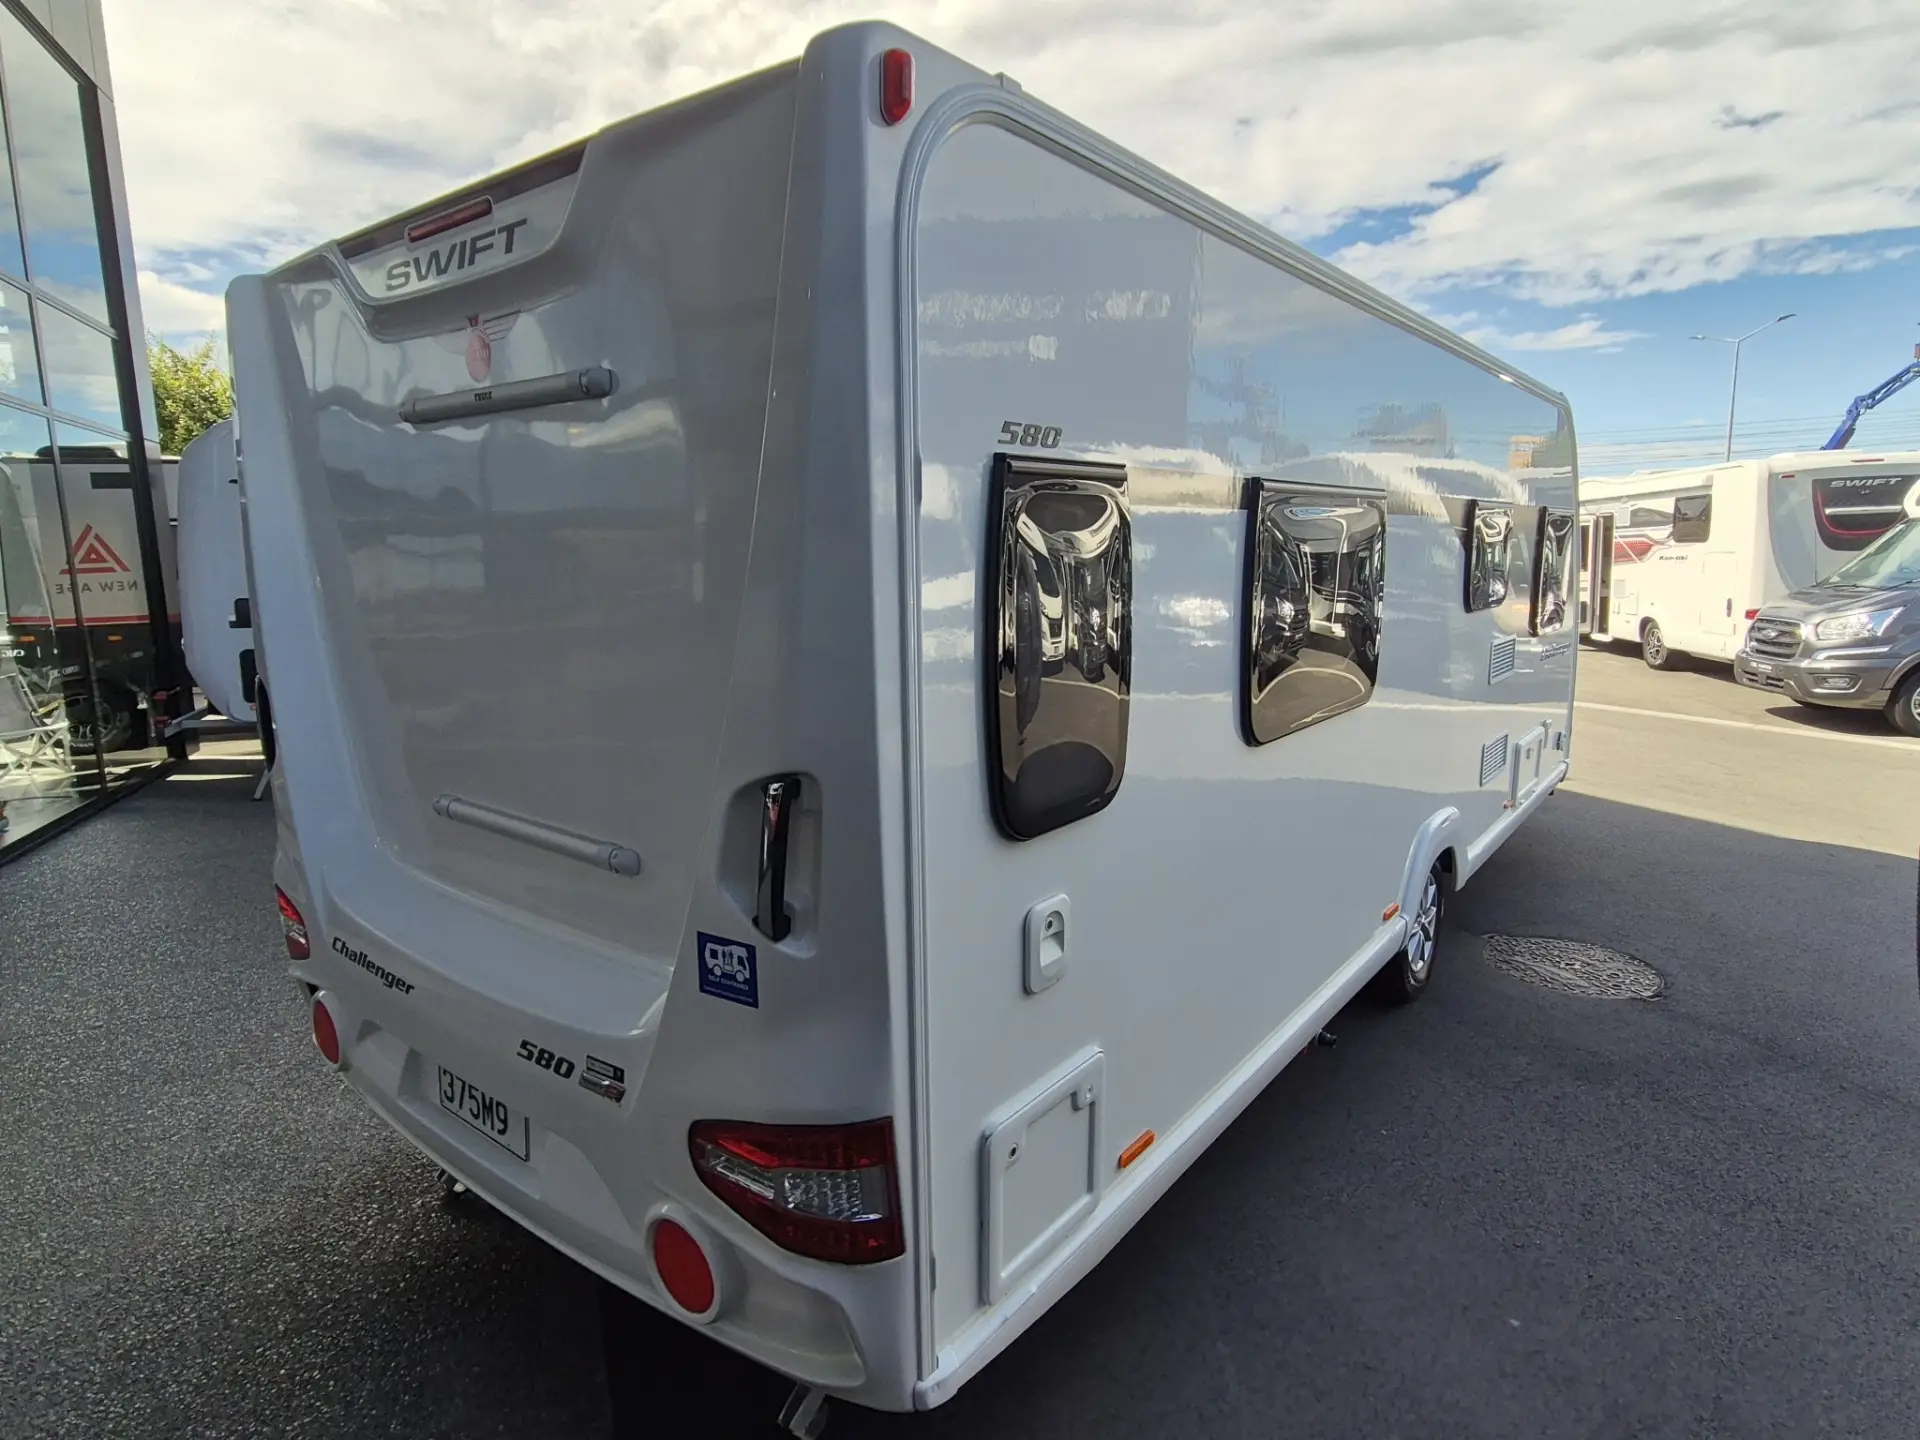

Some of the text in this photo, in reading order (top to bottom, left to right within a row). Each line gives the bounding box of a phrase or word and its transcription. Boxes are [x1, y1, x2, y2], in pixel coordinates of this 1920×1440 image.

[385, 218, 528, 292] SWIFT
[997, 420, 1063, 449] 580
[1829, 477, 1903, 488] SWIFT
[331, 935, 415, 997] Challenger
[516, 1038, 576, 1081] 580
[442, 1068, 509, 1136] 375M9
